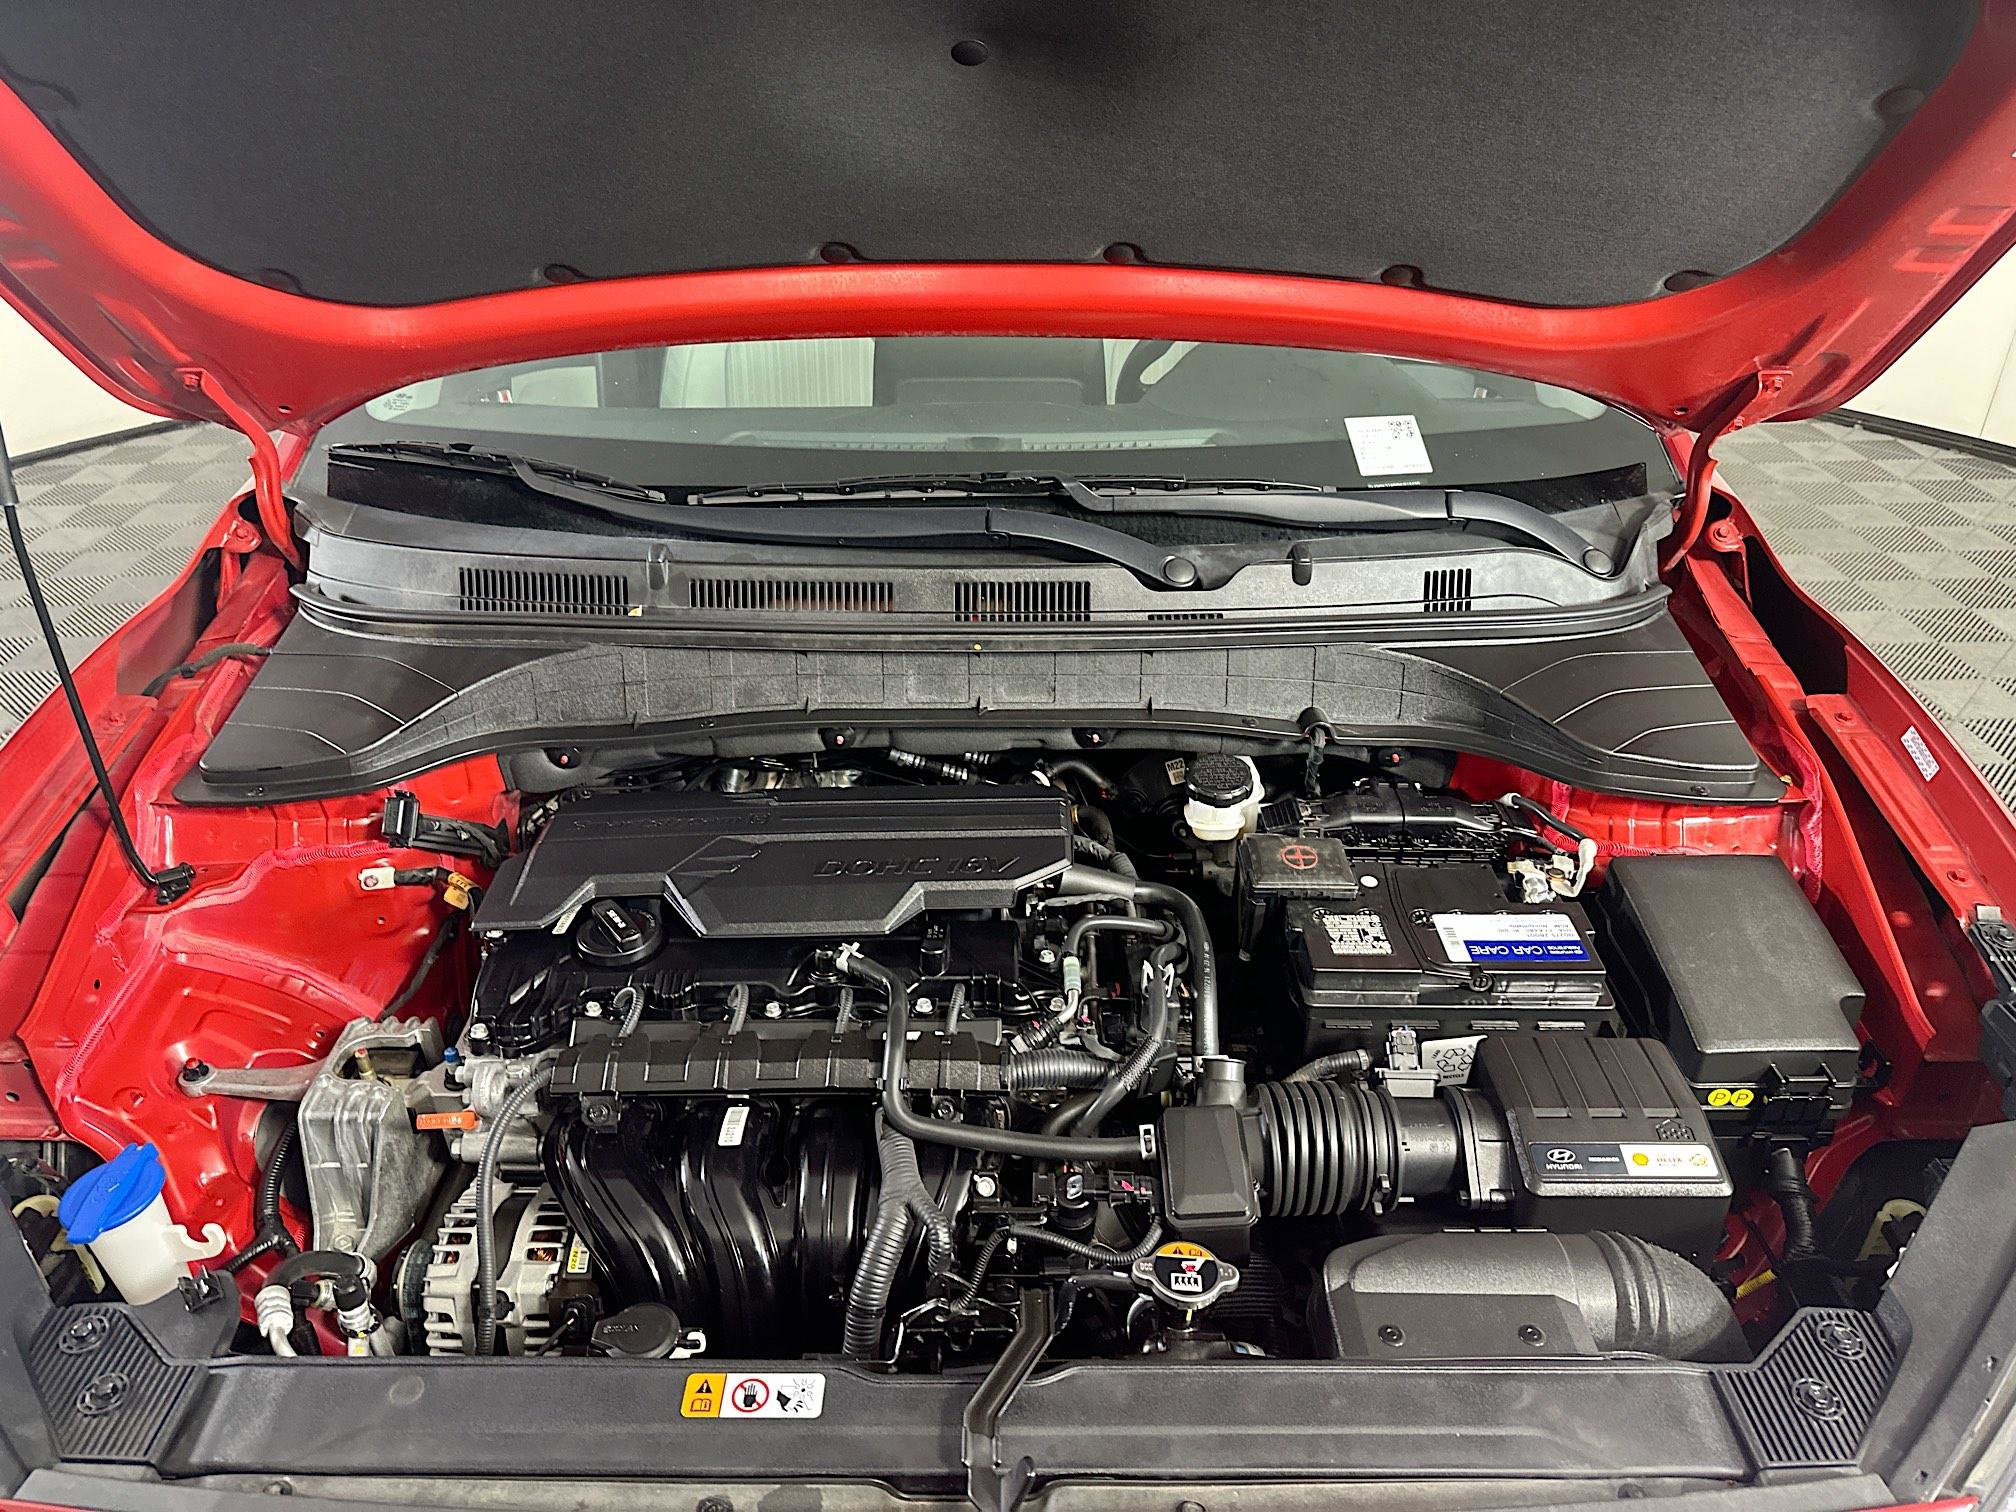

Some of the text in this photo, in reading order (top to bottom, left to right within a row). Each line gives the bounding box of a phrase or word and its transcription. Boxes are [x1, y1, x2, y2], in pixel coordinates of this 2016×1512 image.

[1166, 760, 1184, 772] M22
[812, 856, 1020, 878] DOHC 16V
[1469, 945, 1509, 955] CARE
[1512, 945, 1543, 955] CAR
[1712, 1092, 1749, 1103] P P
[570, 1251, 578, 1269] N20
